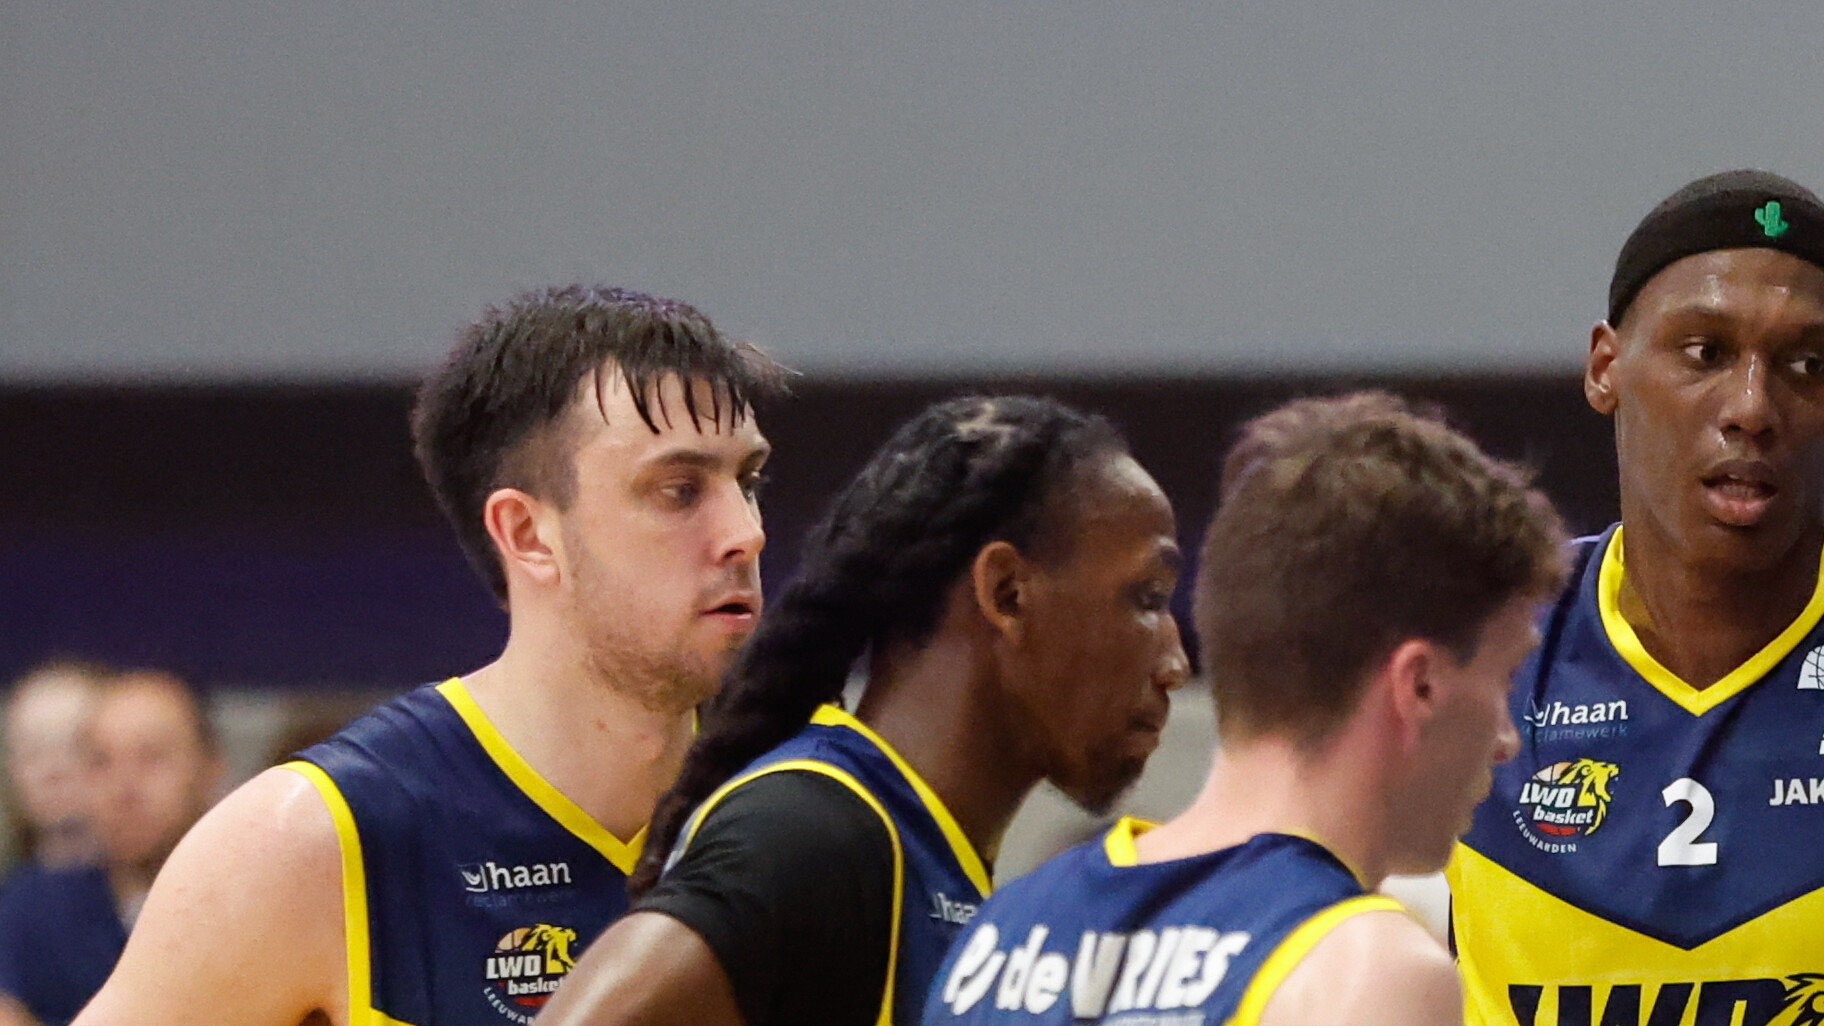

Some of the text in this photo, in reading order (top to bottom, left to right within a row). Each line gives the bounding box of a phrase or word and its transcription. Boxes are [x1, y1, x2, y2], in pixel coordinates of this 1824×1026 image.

[1551, 700, 1628, 725] haan
[1519, 783, 1576, 808] LWD
[1533, 805, 1594, 824] basket
[1658, 777, 1718, 866] 2
[1513, 811, 1577, 853] LEEUWARDEN
[485, 862, 571, 890] haan
[486, 955, 541, 979] LWD
[996, 924, 1068, 1015] de
[1072, 926, 1251, 1018] VRIES
